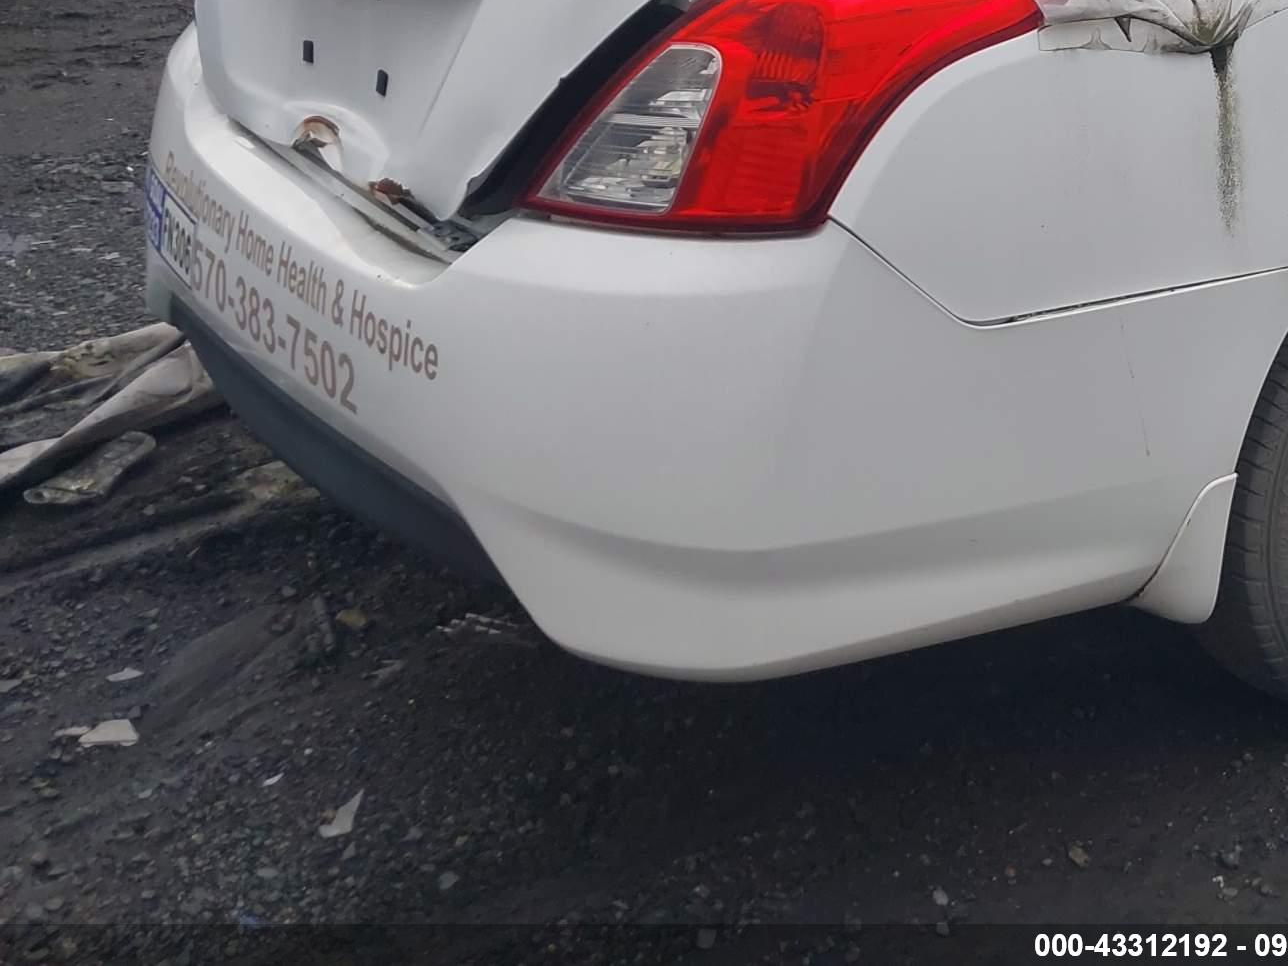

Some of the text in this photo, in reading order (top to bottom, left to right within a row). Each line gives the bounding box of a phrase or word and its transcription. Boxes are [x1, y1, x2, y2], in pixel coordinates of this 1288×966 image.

[165, 151, 236, 254] Revolutionary
[236, 210, 275, 277] Home
[277, 240, 327, 318] Health
[331, 279, 345, 327] &
[350, 289, 439, 380] Hospice
[191, 239, 358, 415] 570-383-7502
